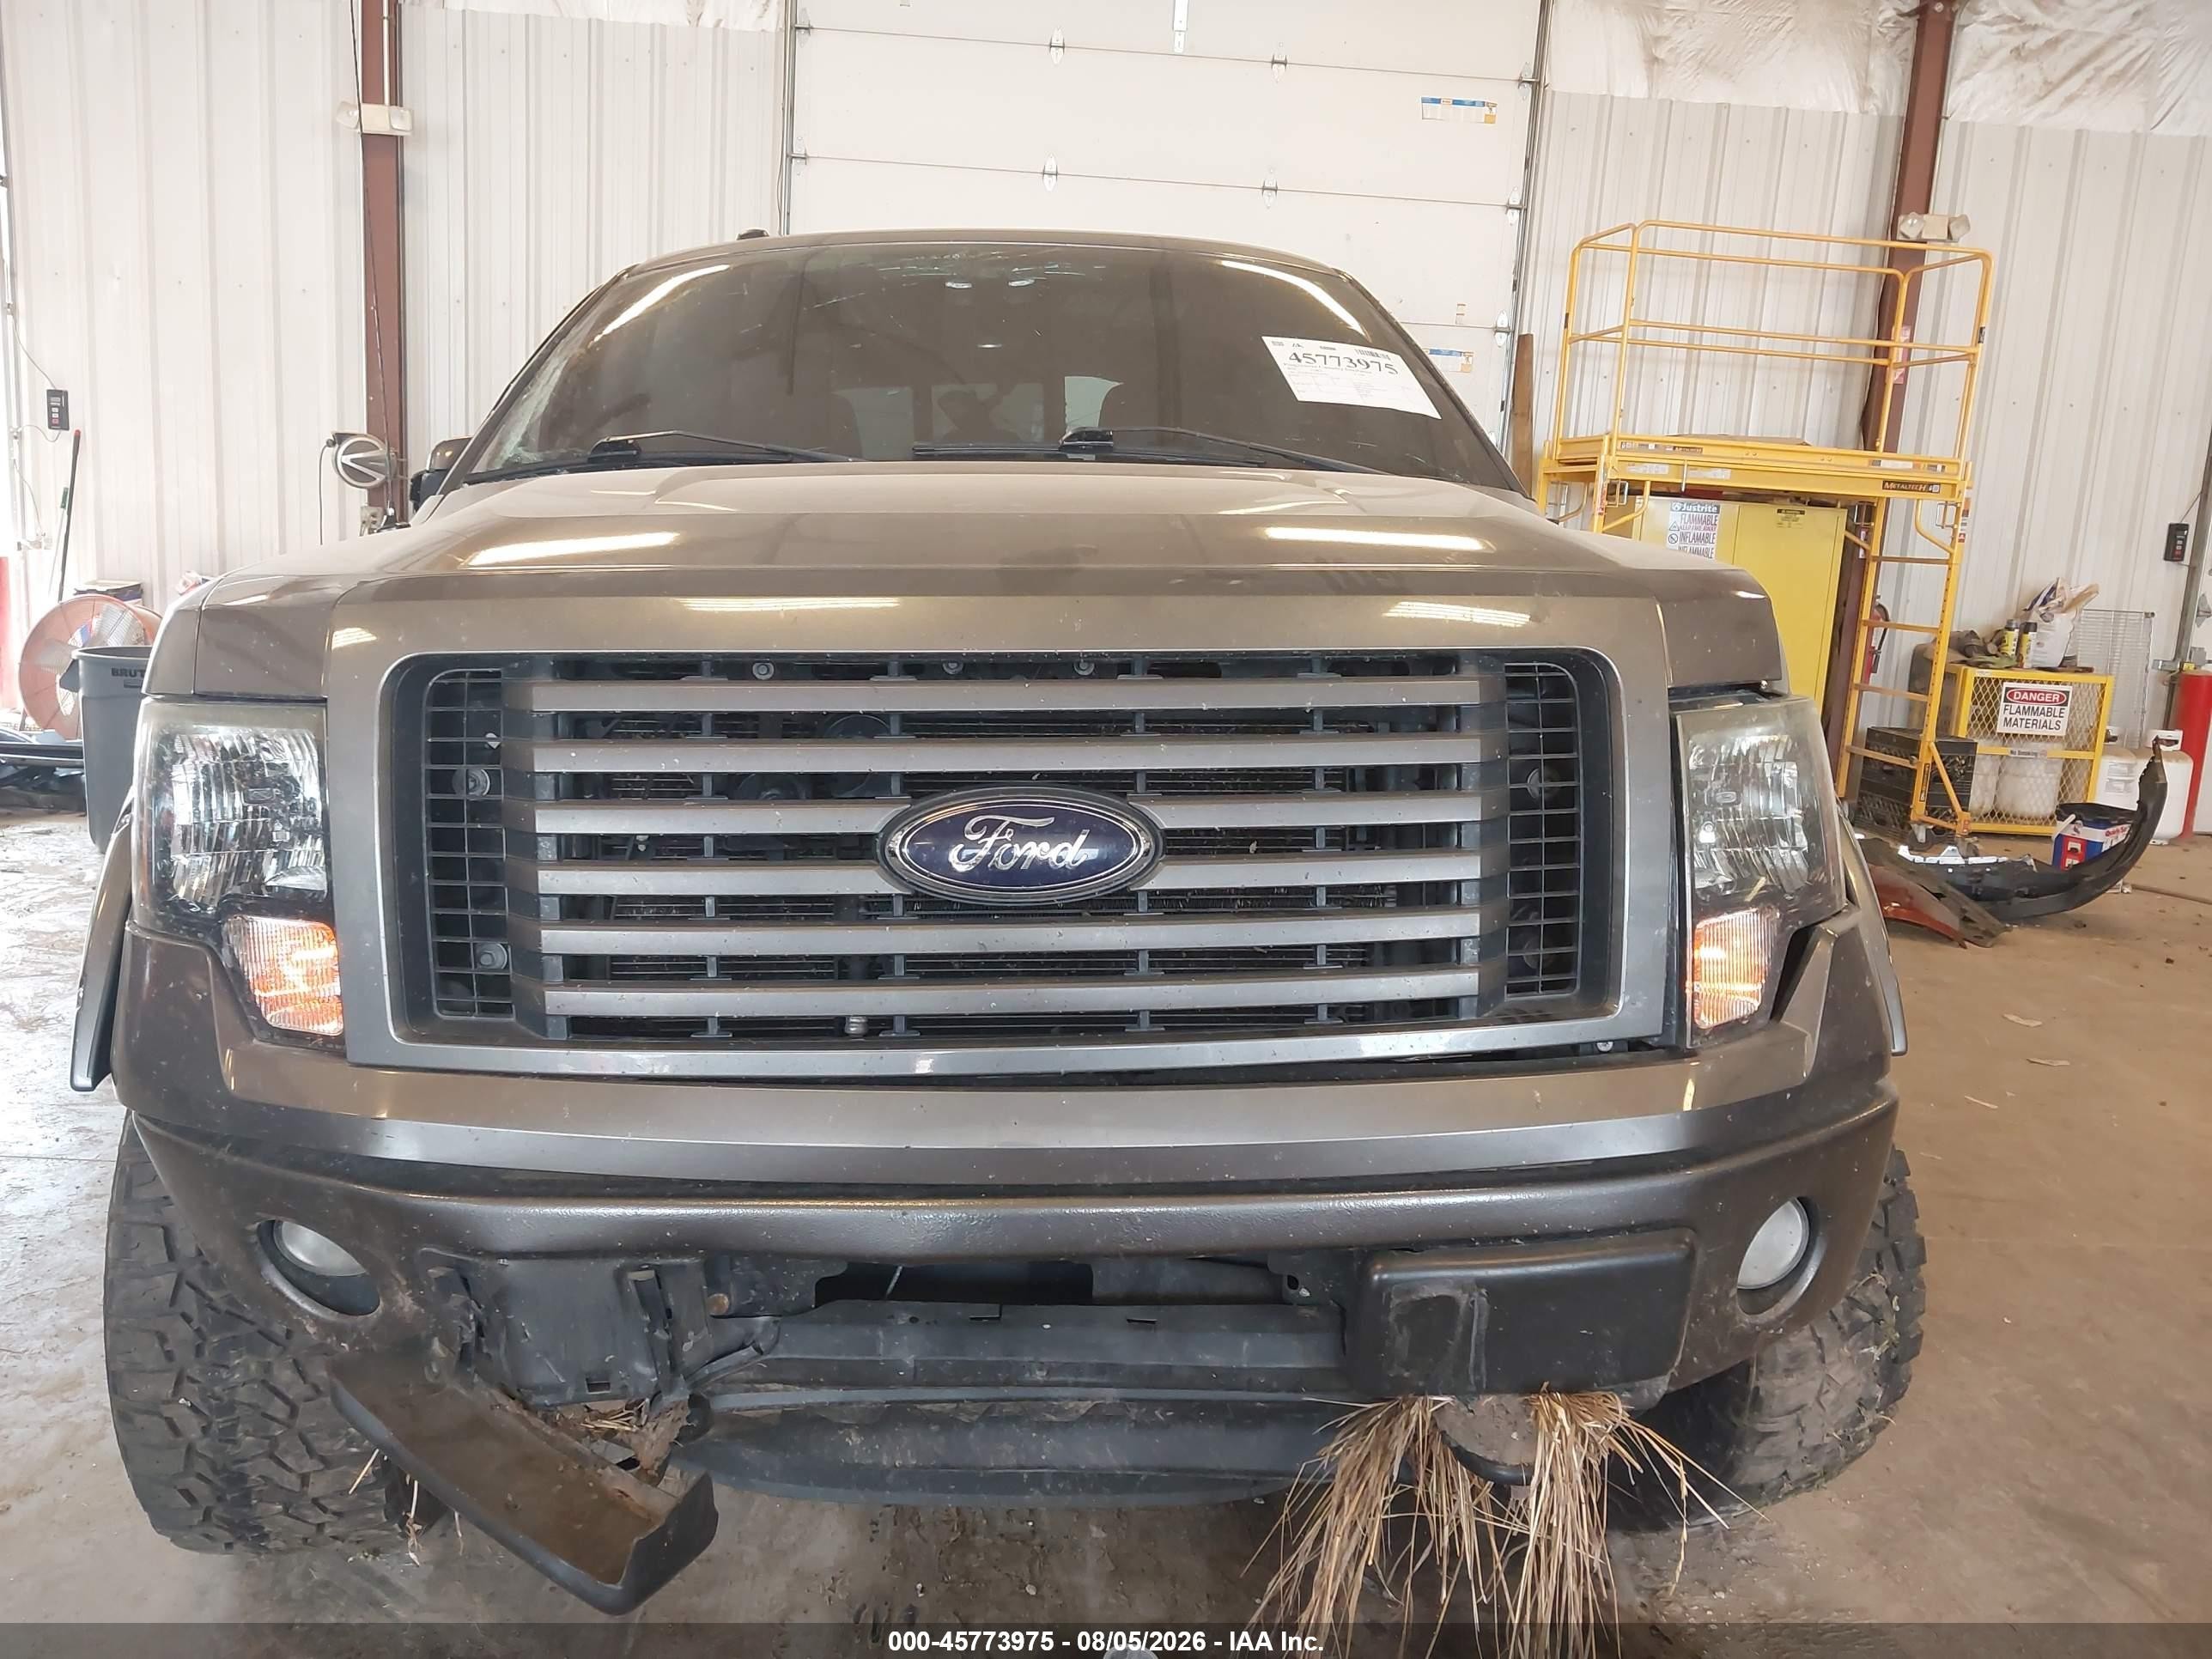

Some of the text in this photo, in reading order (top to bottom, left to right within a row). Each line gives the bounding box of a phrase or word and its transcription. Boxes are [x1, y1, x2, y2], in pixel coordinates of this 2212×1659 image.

[1289, 352, 1399, 374] 45773975
[1681, 502, 1717, 513] Justrite
[1680, 514, 1718, 526] FLAMMABLE
[1679, 531, 1716, 544] INFLAMABLE
[111, 667, 146, 678] BRUT
[2013, 691, 2060, 702] DANGER
[2003, 704, 2065, 718] FLAMMABLE
[2003, 717, 2061, 731] MATERIALS
[948, 815, 1090, 872] Ford
